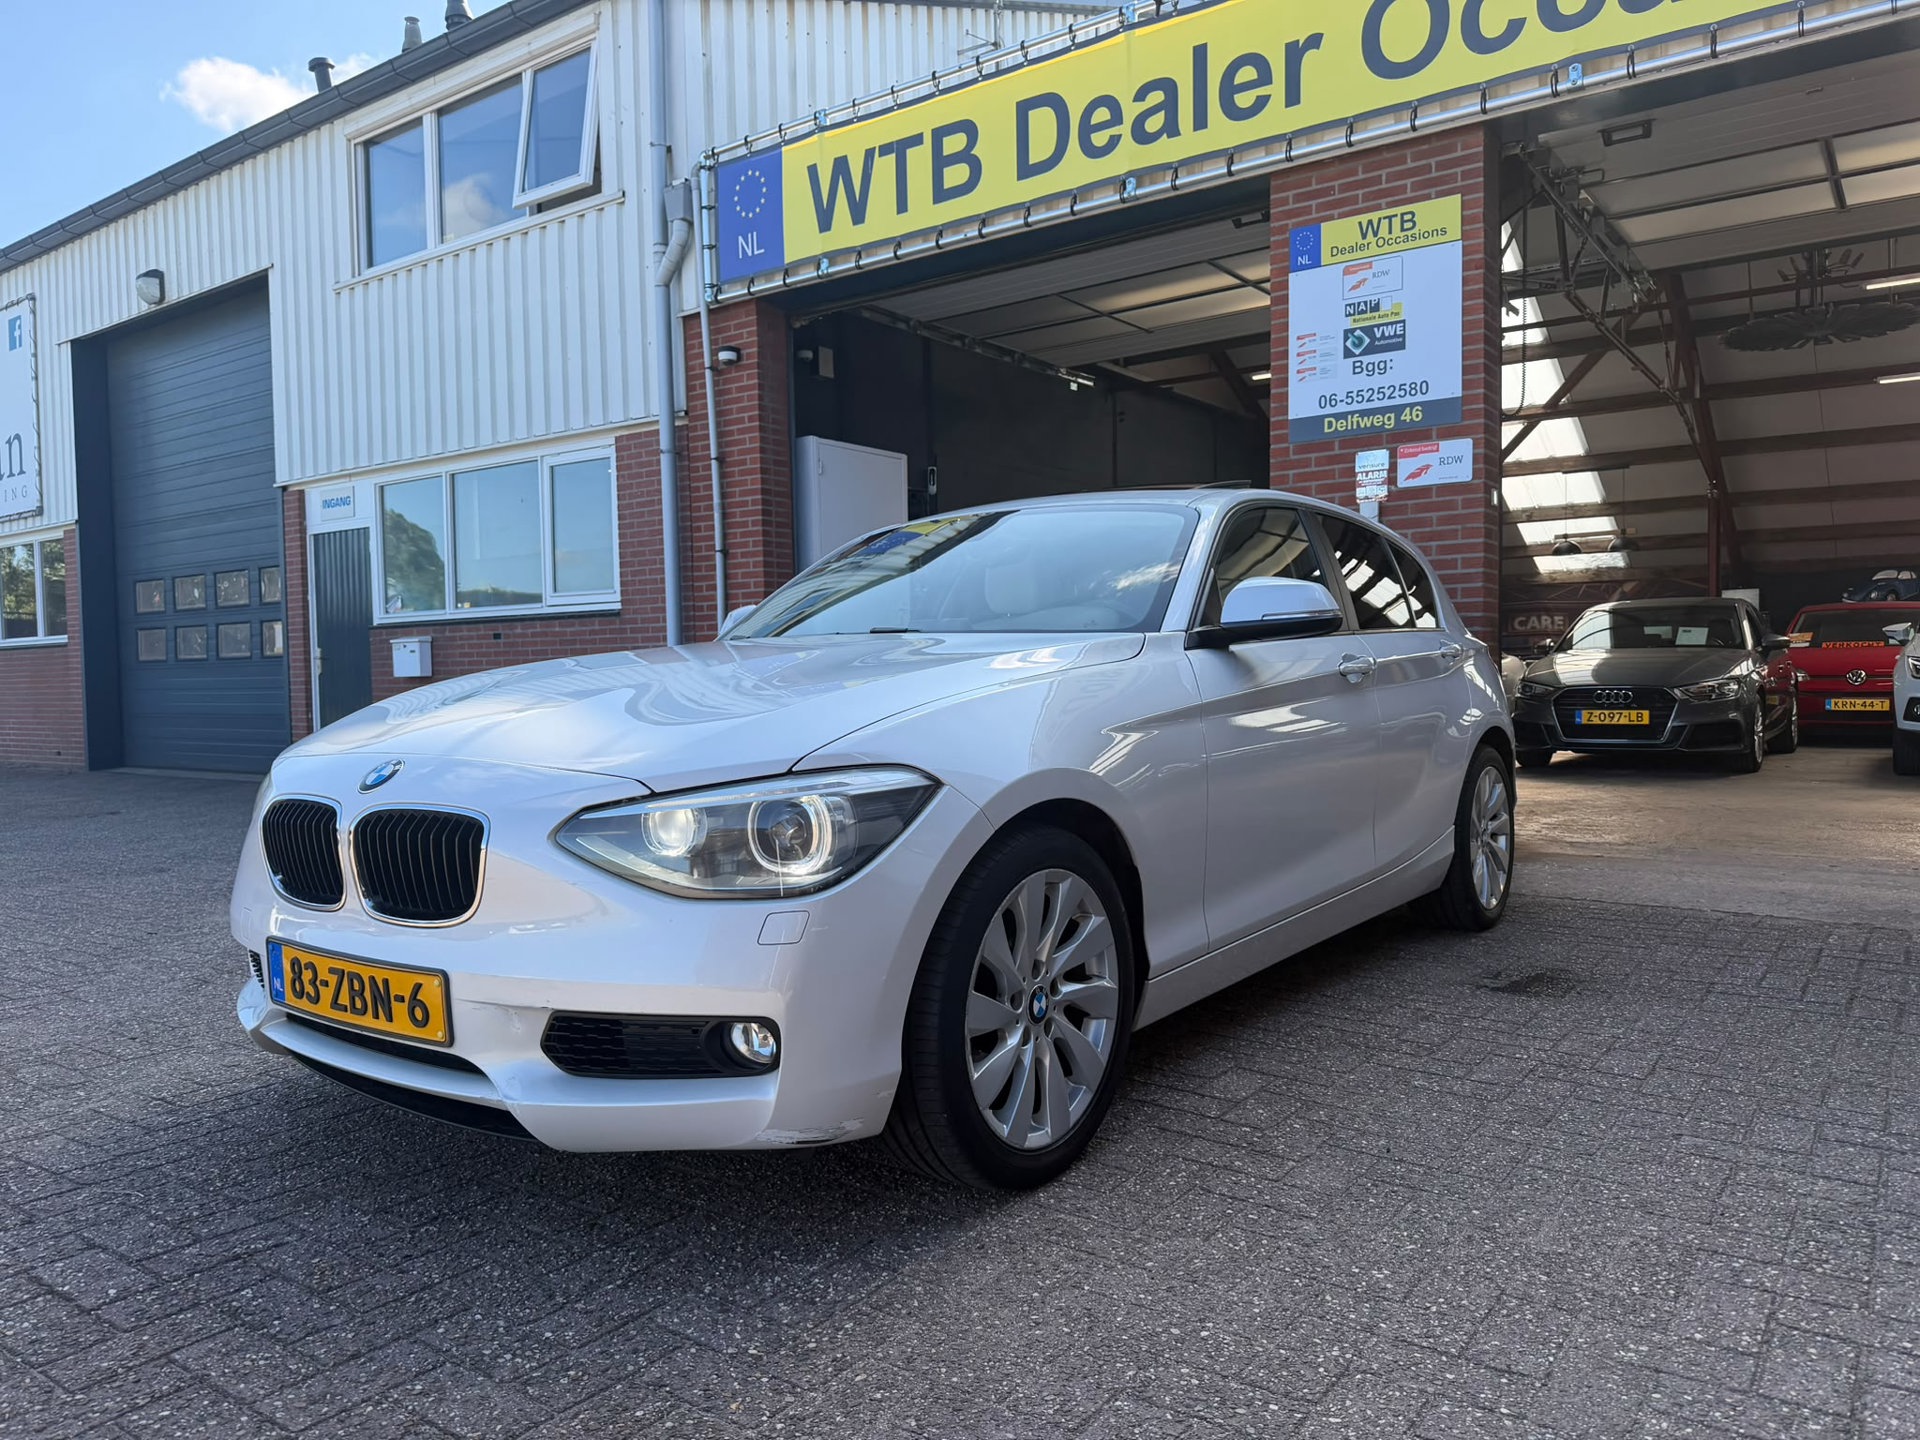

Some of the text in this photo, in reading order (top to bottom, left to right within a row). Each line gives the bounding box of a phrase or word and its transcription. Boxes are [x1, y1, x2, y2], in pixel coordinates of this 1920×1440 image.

[807, 118, 983, 235] WTB
[1015, 31, 1325, 182] Dealer
[1358, 210, 1418, 241] WTB
[738, 232, 765, 259] NL
[1330, 226, 1448, 257] Dealer Occasions
[1297, 255, 1312, 266] NL
[1346, 298, 1380, 316] NAP
[1373, 323, 1405, 338] VWE
[1352, 358, 1393, 377] Bgg:
[1318, 380, 1430, 409] 06-55252580
[1323, 405, 1423, 433] Delfweg 46
[1438, 455, 1464, 466] RDW
[1356, 470, 1388, 481] ALARM
[322, 495, 351, 509] INGANG
[1513, 615, 1564, 630] CARE
[1833, 700, 1886, 709] KRN-44-T
[1586, 711, 1644, 723] Z-097-LB
[289, 956, 431, 1029] 83-ZBN-6
